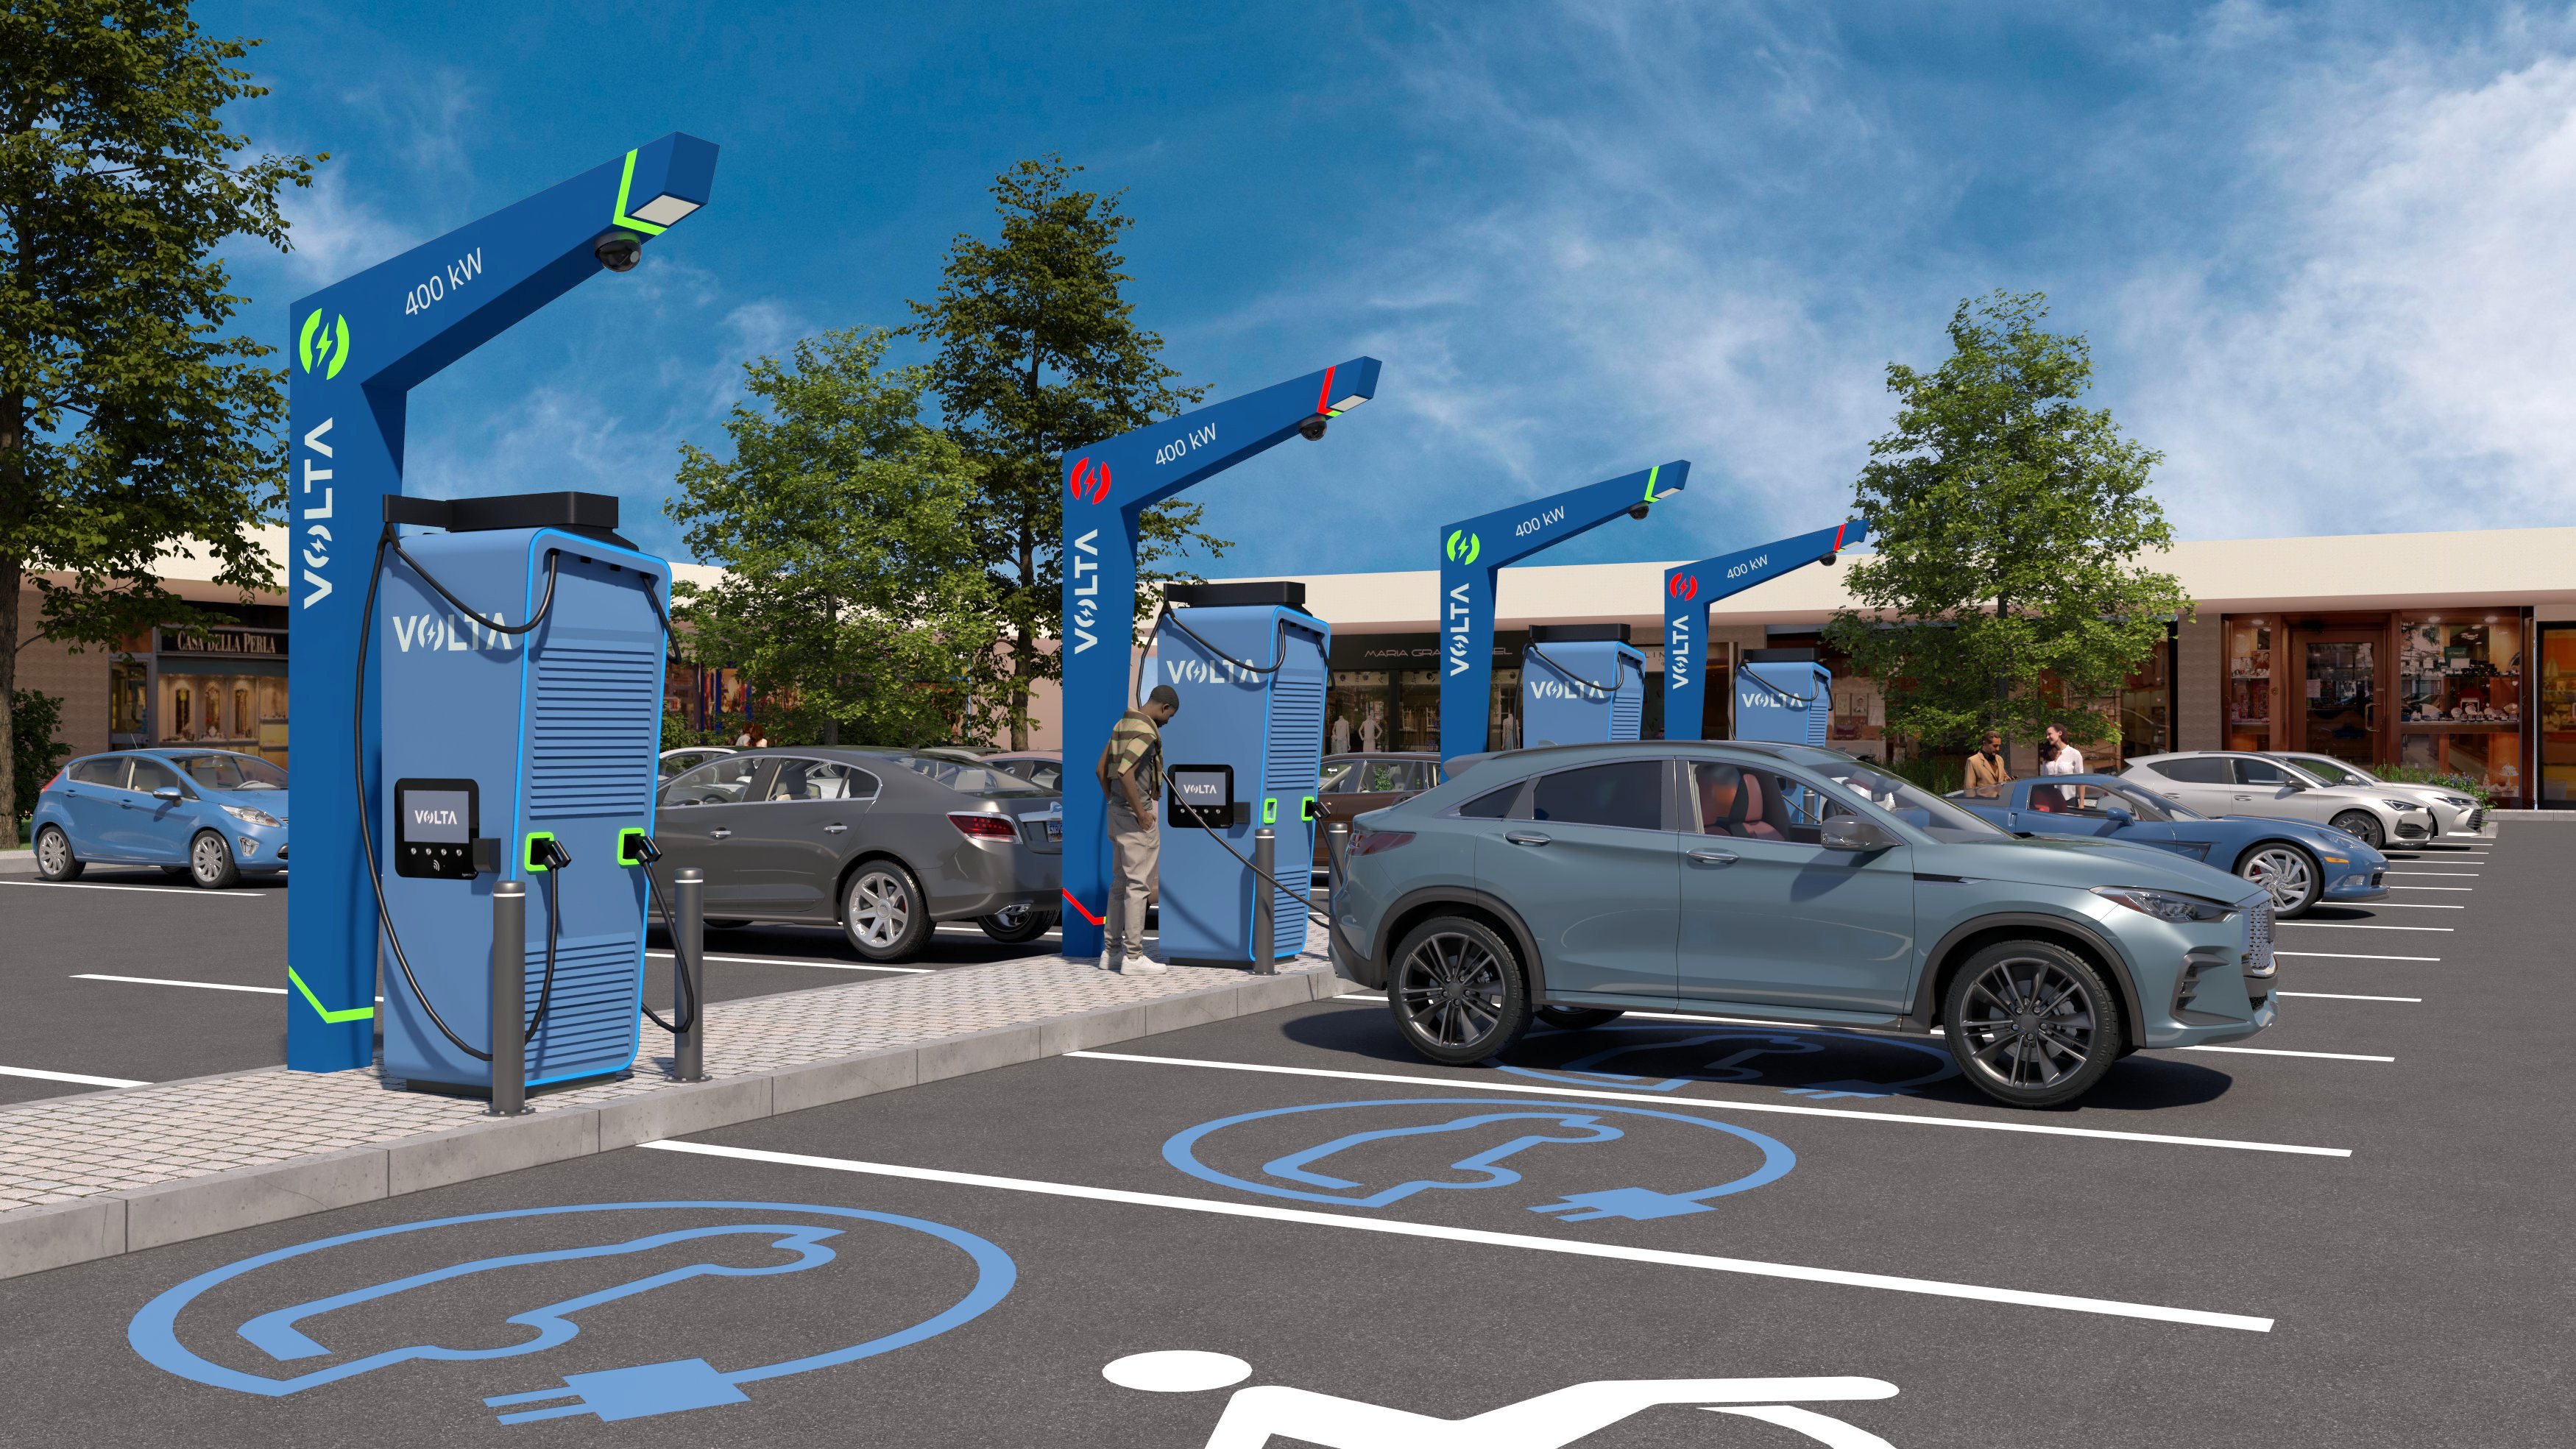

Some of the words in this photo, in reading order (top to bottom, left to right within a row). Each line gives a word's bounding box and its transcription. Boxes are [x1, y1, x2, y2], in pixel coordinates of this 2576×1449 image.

[406, 275, 444, 316] 400
[447, 247, 482, 291] kW
[1156, 439, 1186, 465] 400
[1190, 422, 1217, 450] kW
[303, 417, 333, 609] VOLTA
[1515, 517, 1540, 536] 400
[1543, 506, 1565, 526] kW
[1727, 564, 1748, 579] 400
[1749, 554, 1768, 570] kW
[1075, 528, 1098, 655] VOLTA
[243, 633, 276, 653] PERLA
[392, 612, 512, 653] VOLTA
[1449, 583, 1470, 677] VOLTA
[1365, 650, 1409, 658] MARIA
[1672, 615, 1689, 690] VOLTA
[1166, 659, 1259, 684] VOLTA
[1530, 680, 1604, 699] VOLTA
[1741, 692, 1803, 708] VOLTA
[1183, 784, 1217, 794] VOLTA
[414, 809, 458, 825] VOLTA
